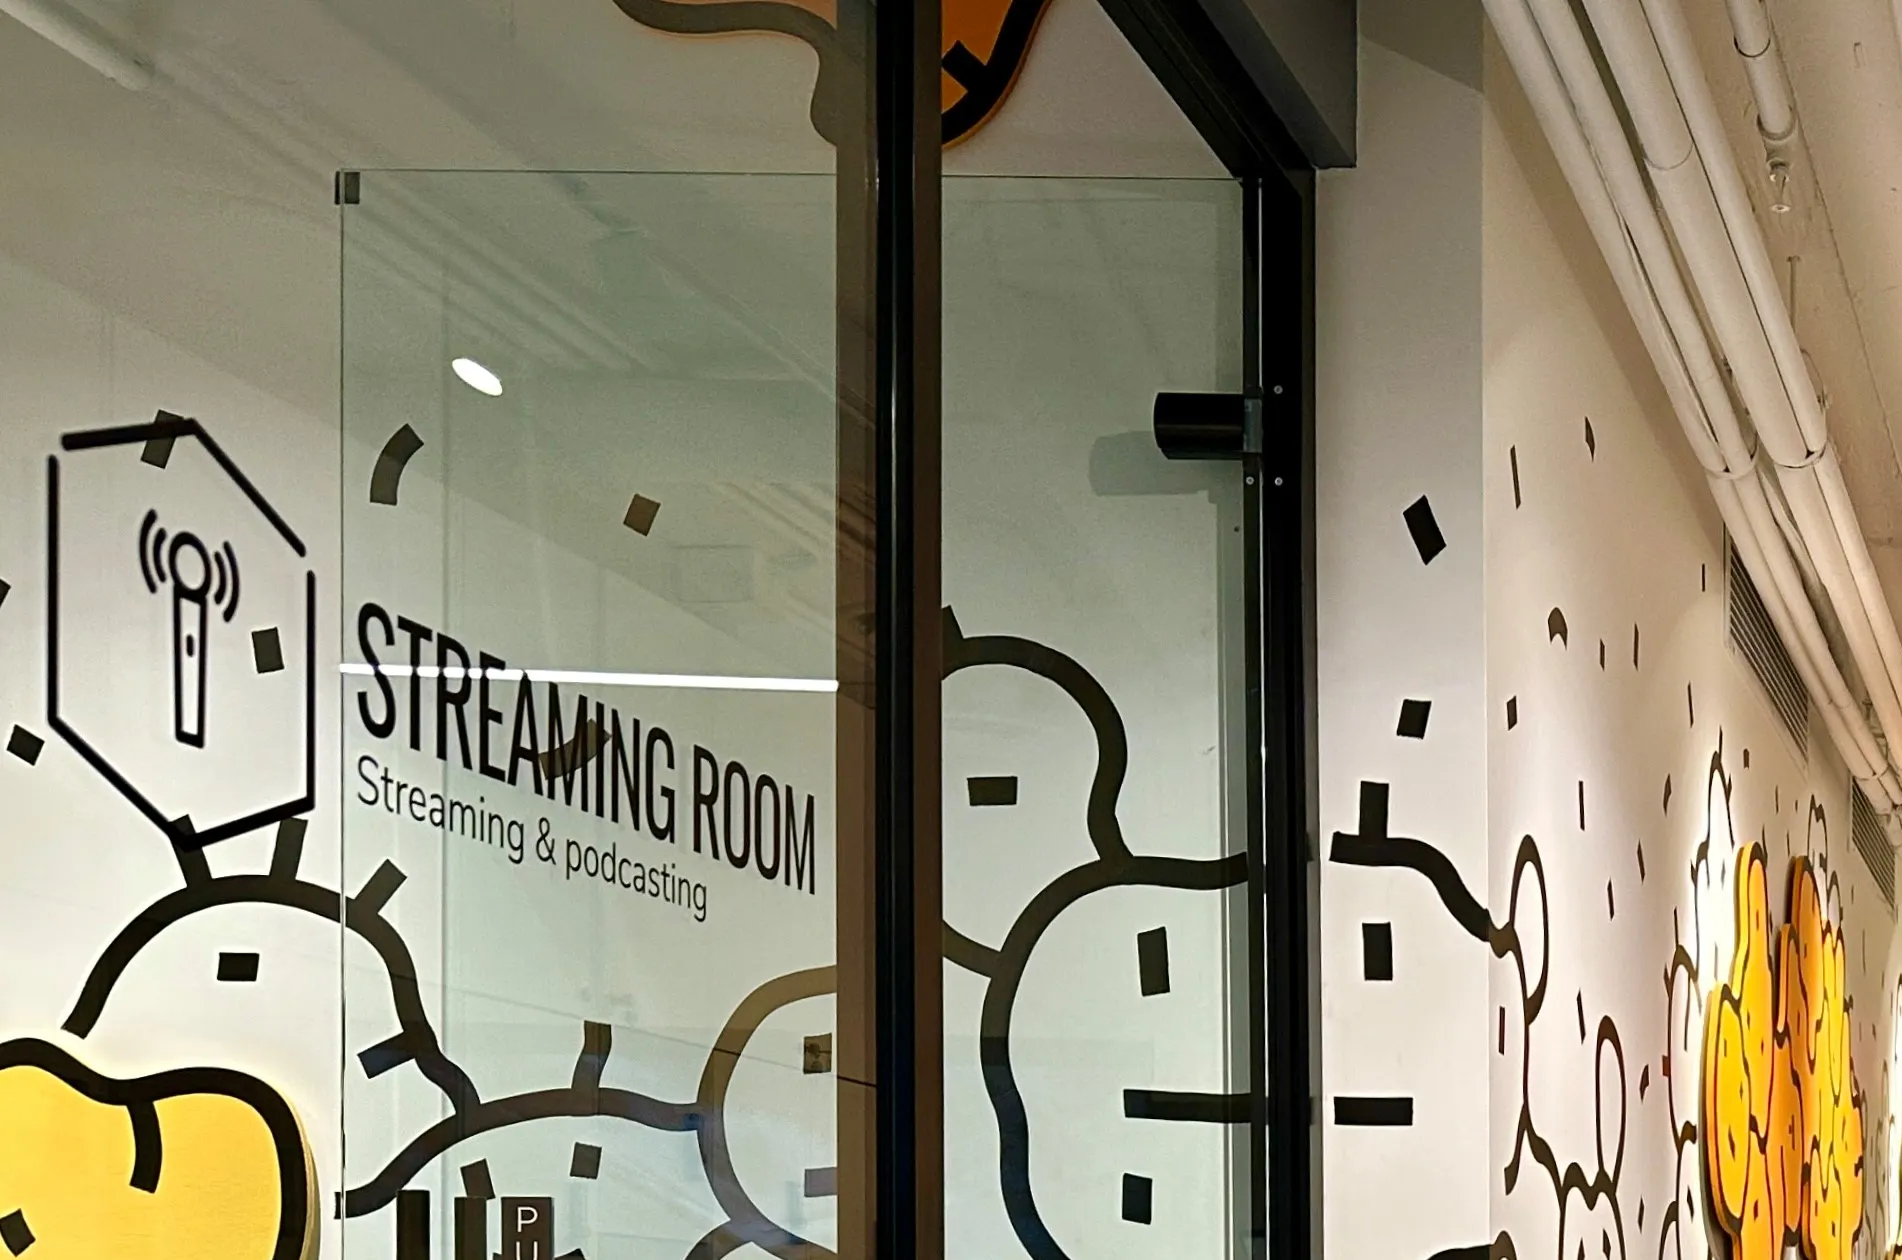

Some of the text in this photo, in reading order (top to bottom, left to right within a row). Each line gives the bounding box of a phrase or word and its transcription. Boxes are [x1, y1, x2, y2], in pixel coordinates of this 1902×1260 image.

[357, 602, 816, 895] STREAMING ROOM
[357, 755, 707, 922] Streaming & podcasting
